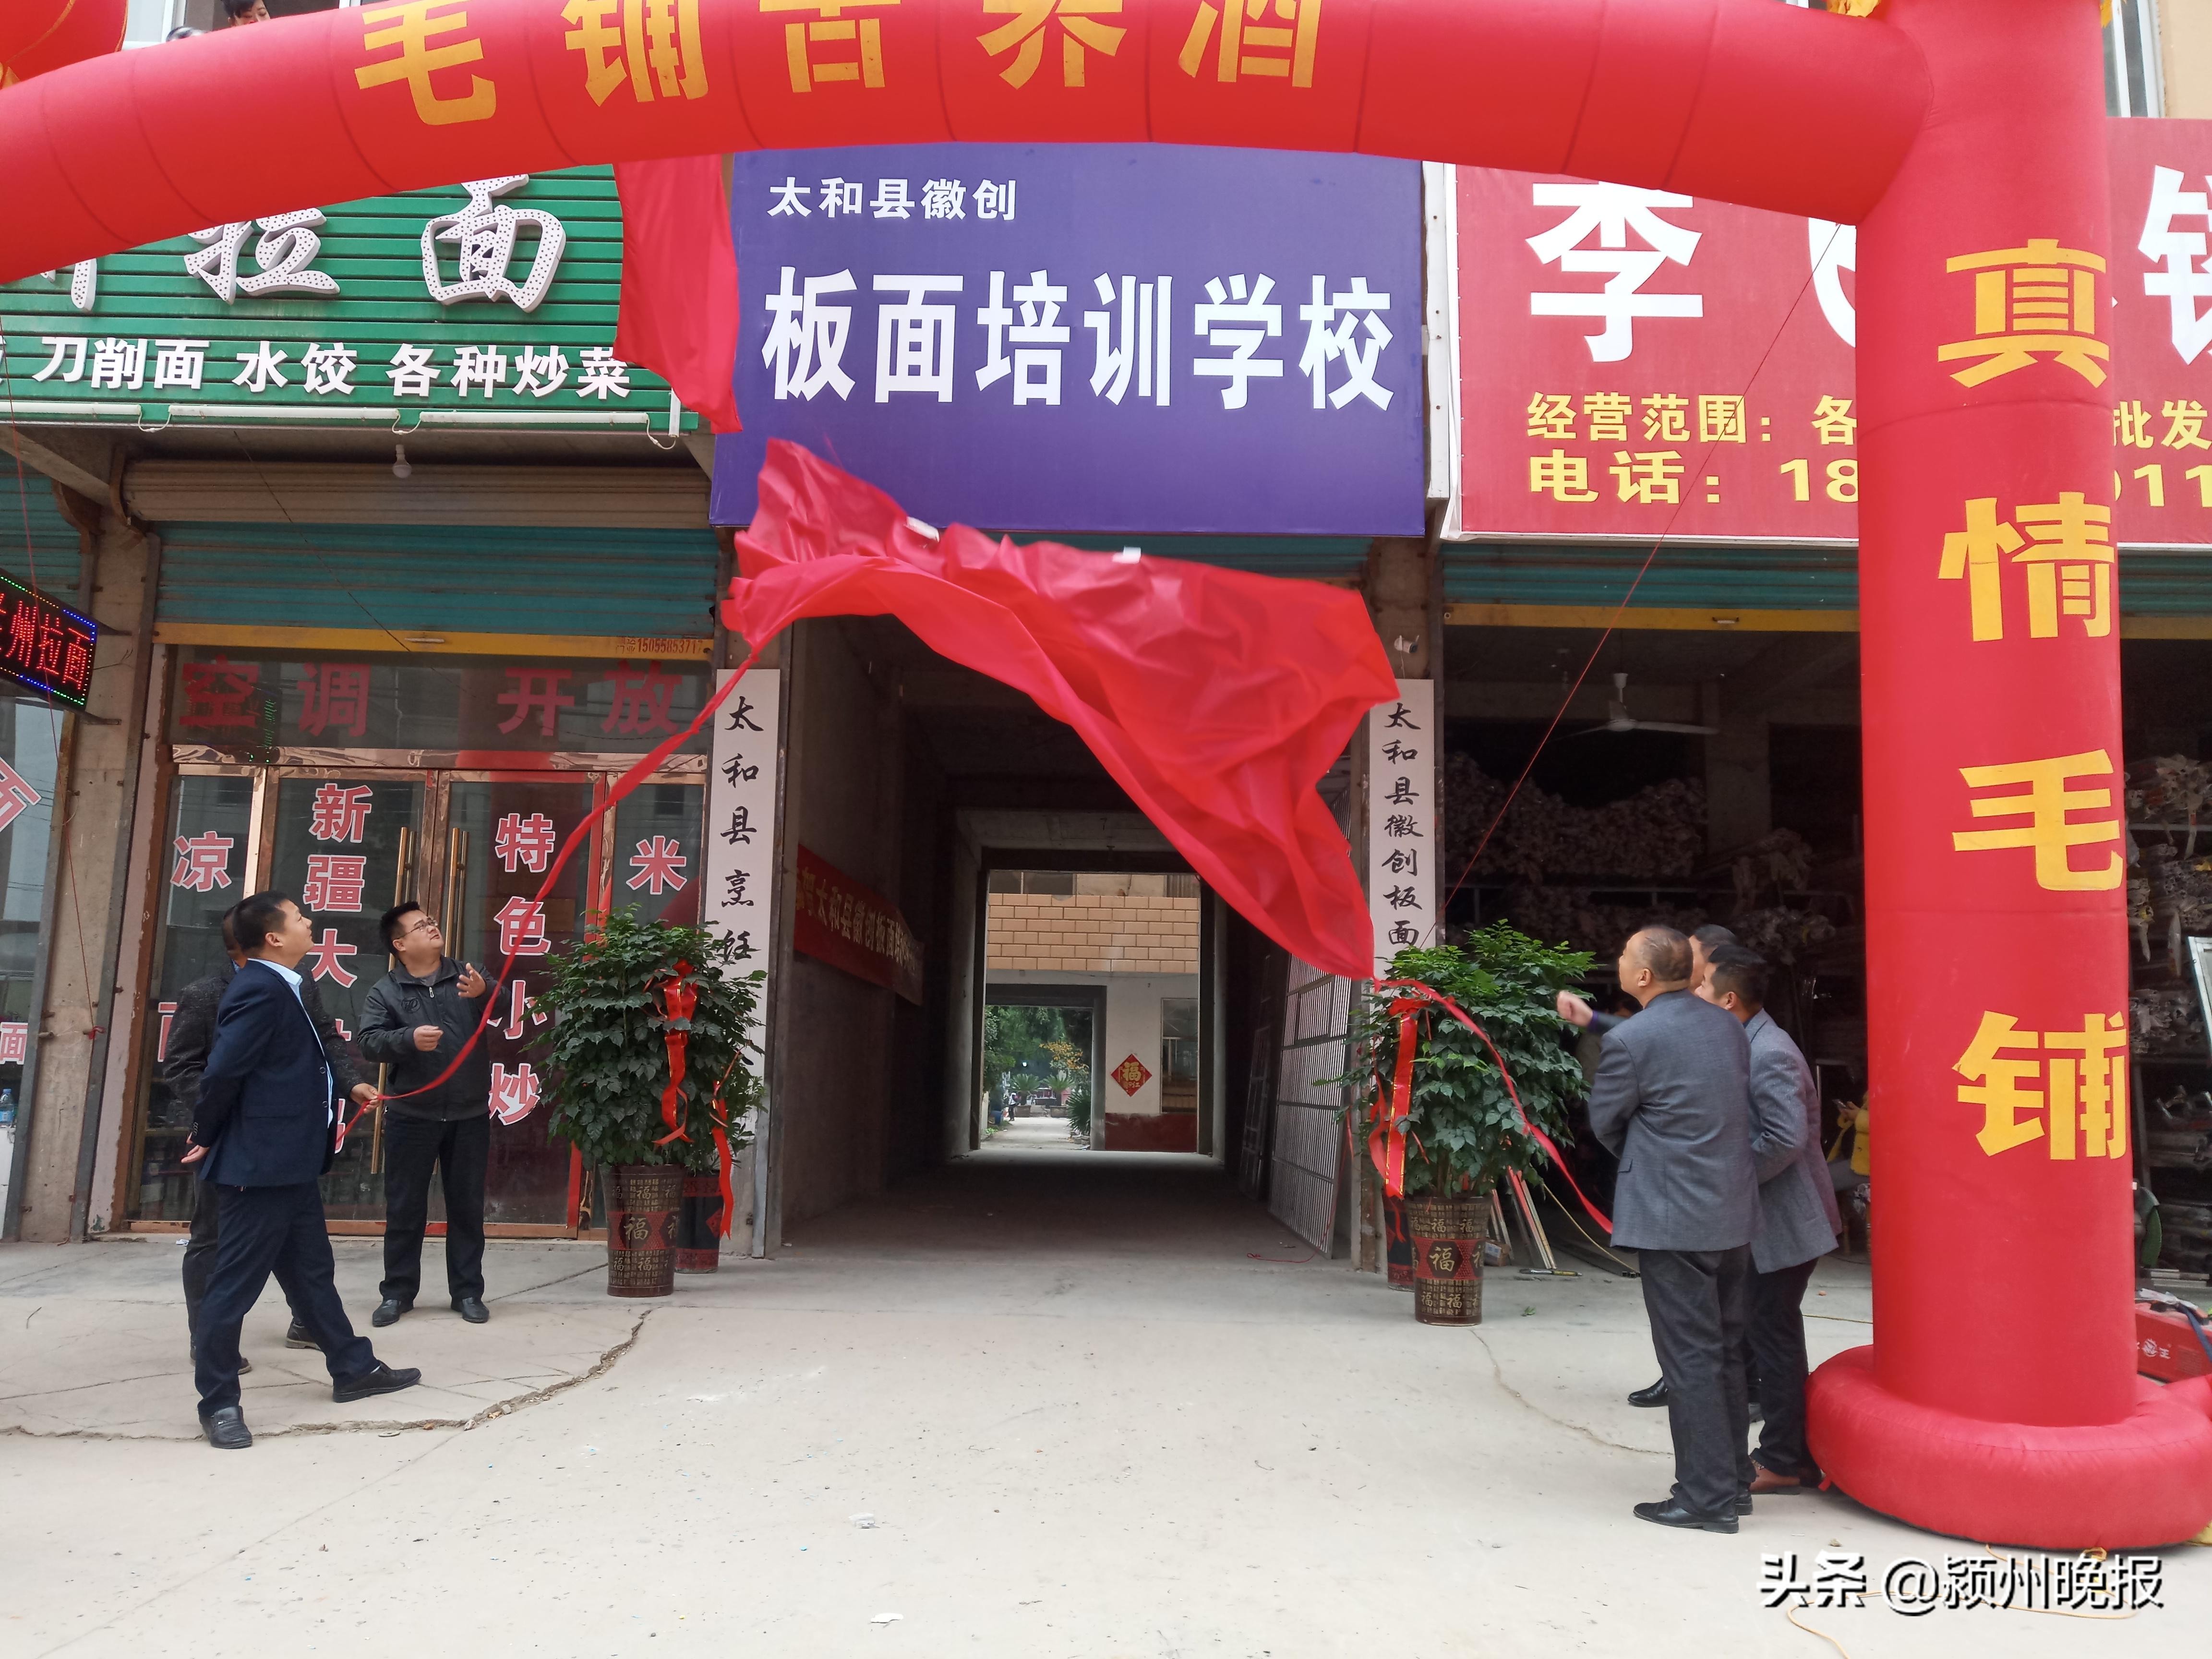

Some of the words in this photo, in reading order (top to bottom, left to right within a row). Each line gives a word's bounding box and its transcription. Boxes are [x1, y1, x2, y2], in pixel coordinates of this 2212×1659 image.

[767, 176, 1017, 222] 太和县徽创
[40, 174, 566, 312] 拉面
[32, 336, 210, 390] 刀削面
[232, 340, 359, 396] 水饺
[385, 342, 630, 400] 各种炒菜
[761, 266, 1395, 412] 板面培训学校
[2114, 464, 2212, 508] 11
[1937, 237, 2130, 1161] 真情毛铺
[1382, 702, 1425, 947] 太和县徽创板面
[487, 812, 556, 1126] 特色小炒
[1122, 1061, 1142, 1082] 福
[624, 1217, 649, 1240] 福
[1429, 1247, 1455, 1272] 福
